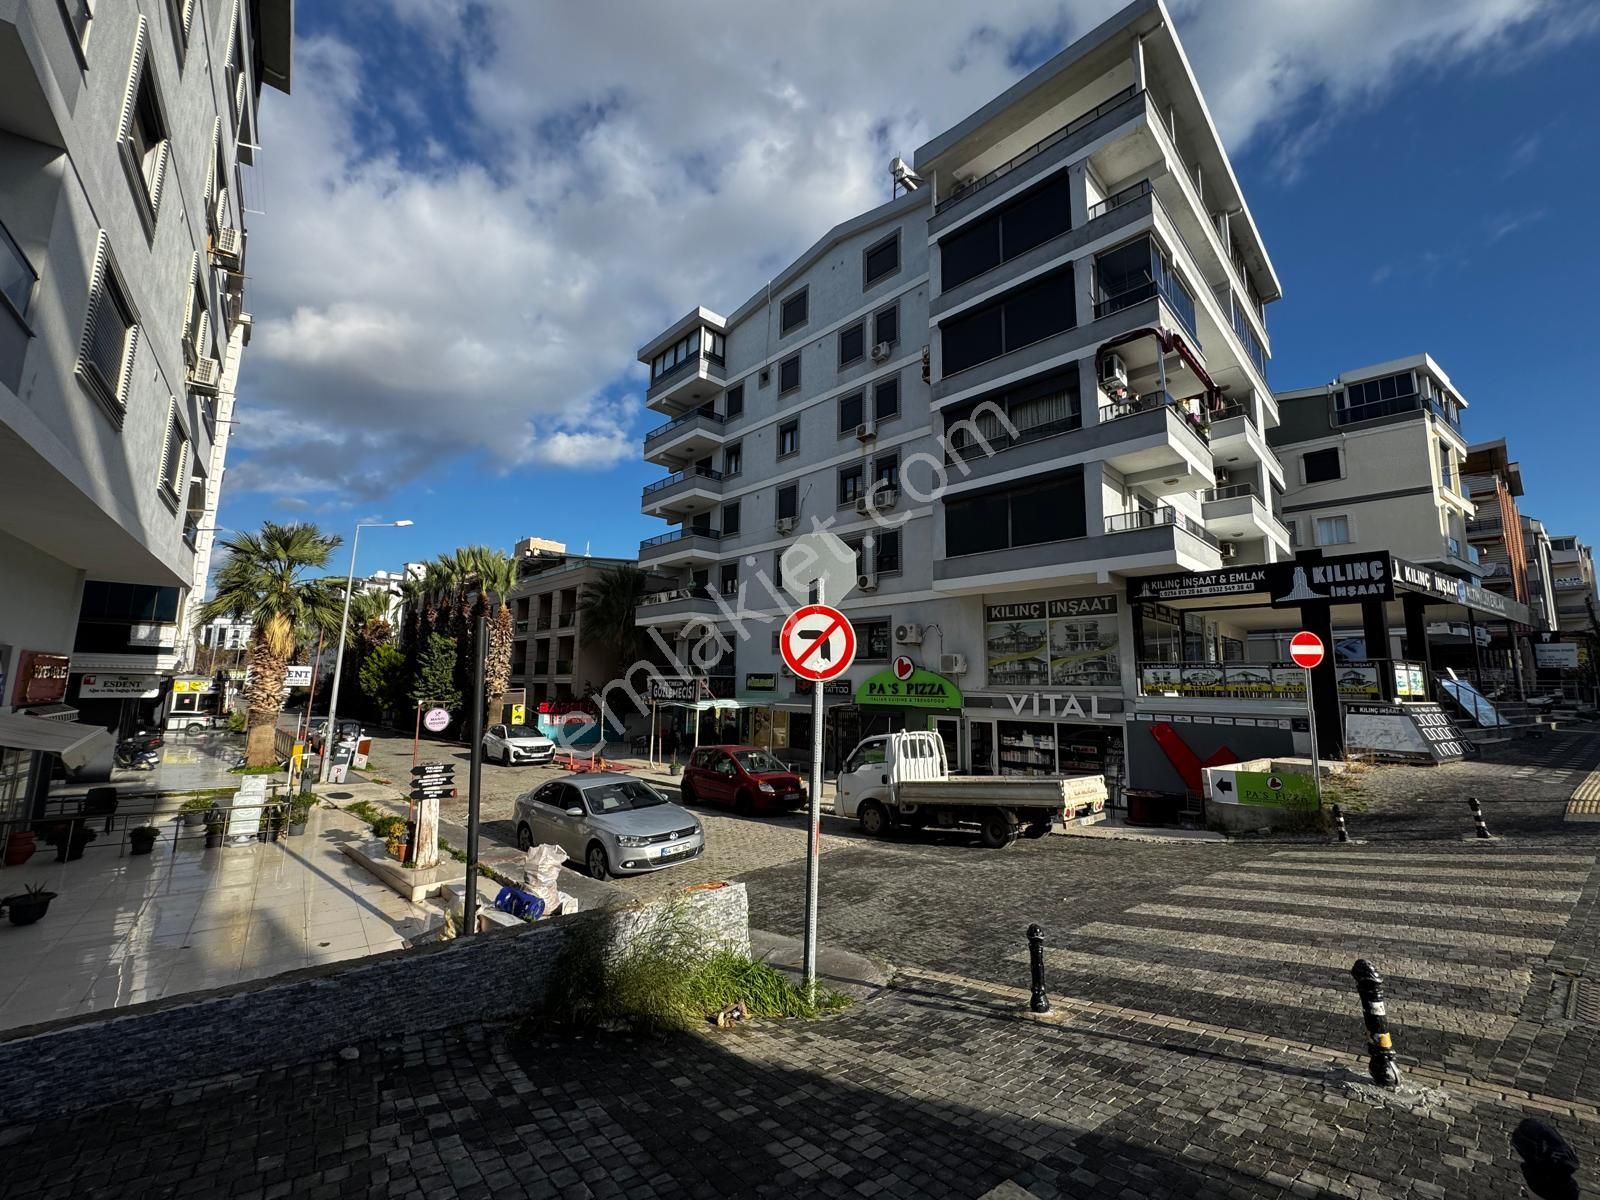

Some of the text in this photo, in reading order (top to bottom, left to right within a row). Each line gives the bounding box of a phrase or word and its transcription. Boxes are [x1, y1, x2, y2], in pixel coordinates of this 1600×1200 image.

[1312, 560, 1384, 584] KILINÇ
[1151, 571, 1266, 590] KILINÇ İNŞAAT & EMLAK
[1404, 566, 1458, 596] KILINÇ İNŞAAT
[1330, 583, 1386, 597] İNŞAAT
[991, 597, 1112, 618] KILINÇ İNŞAAT
[286, 670, 310, 679] ENT
[103, 680, 142, 688] ESDENT
[824, 686, 849, 694] TATTOO
[906, 683, 946, 695] PIZZA
[1005, 692, 1111, 720] VİTAL
